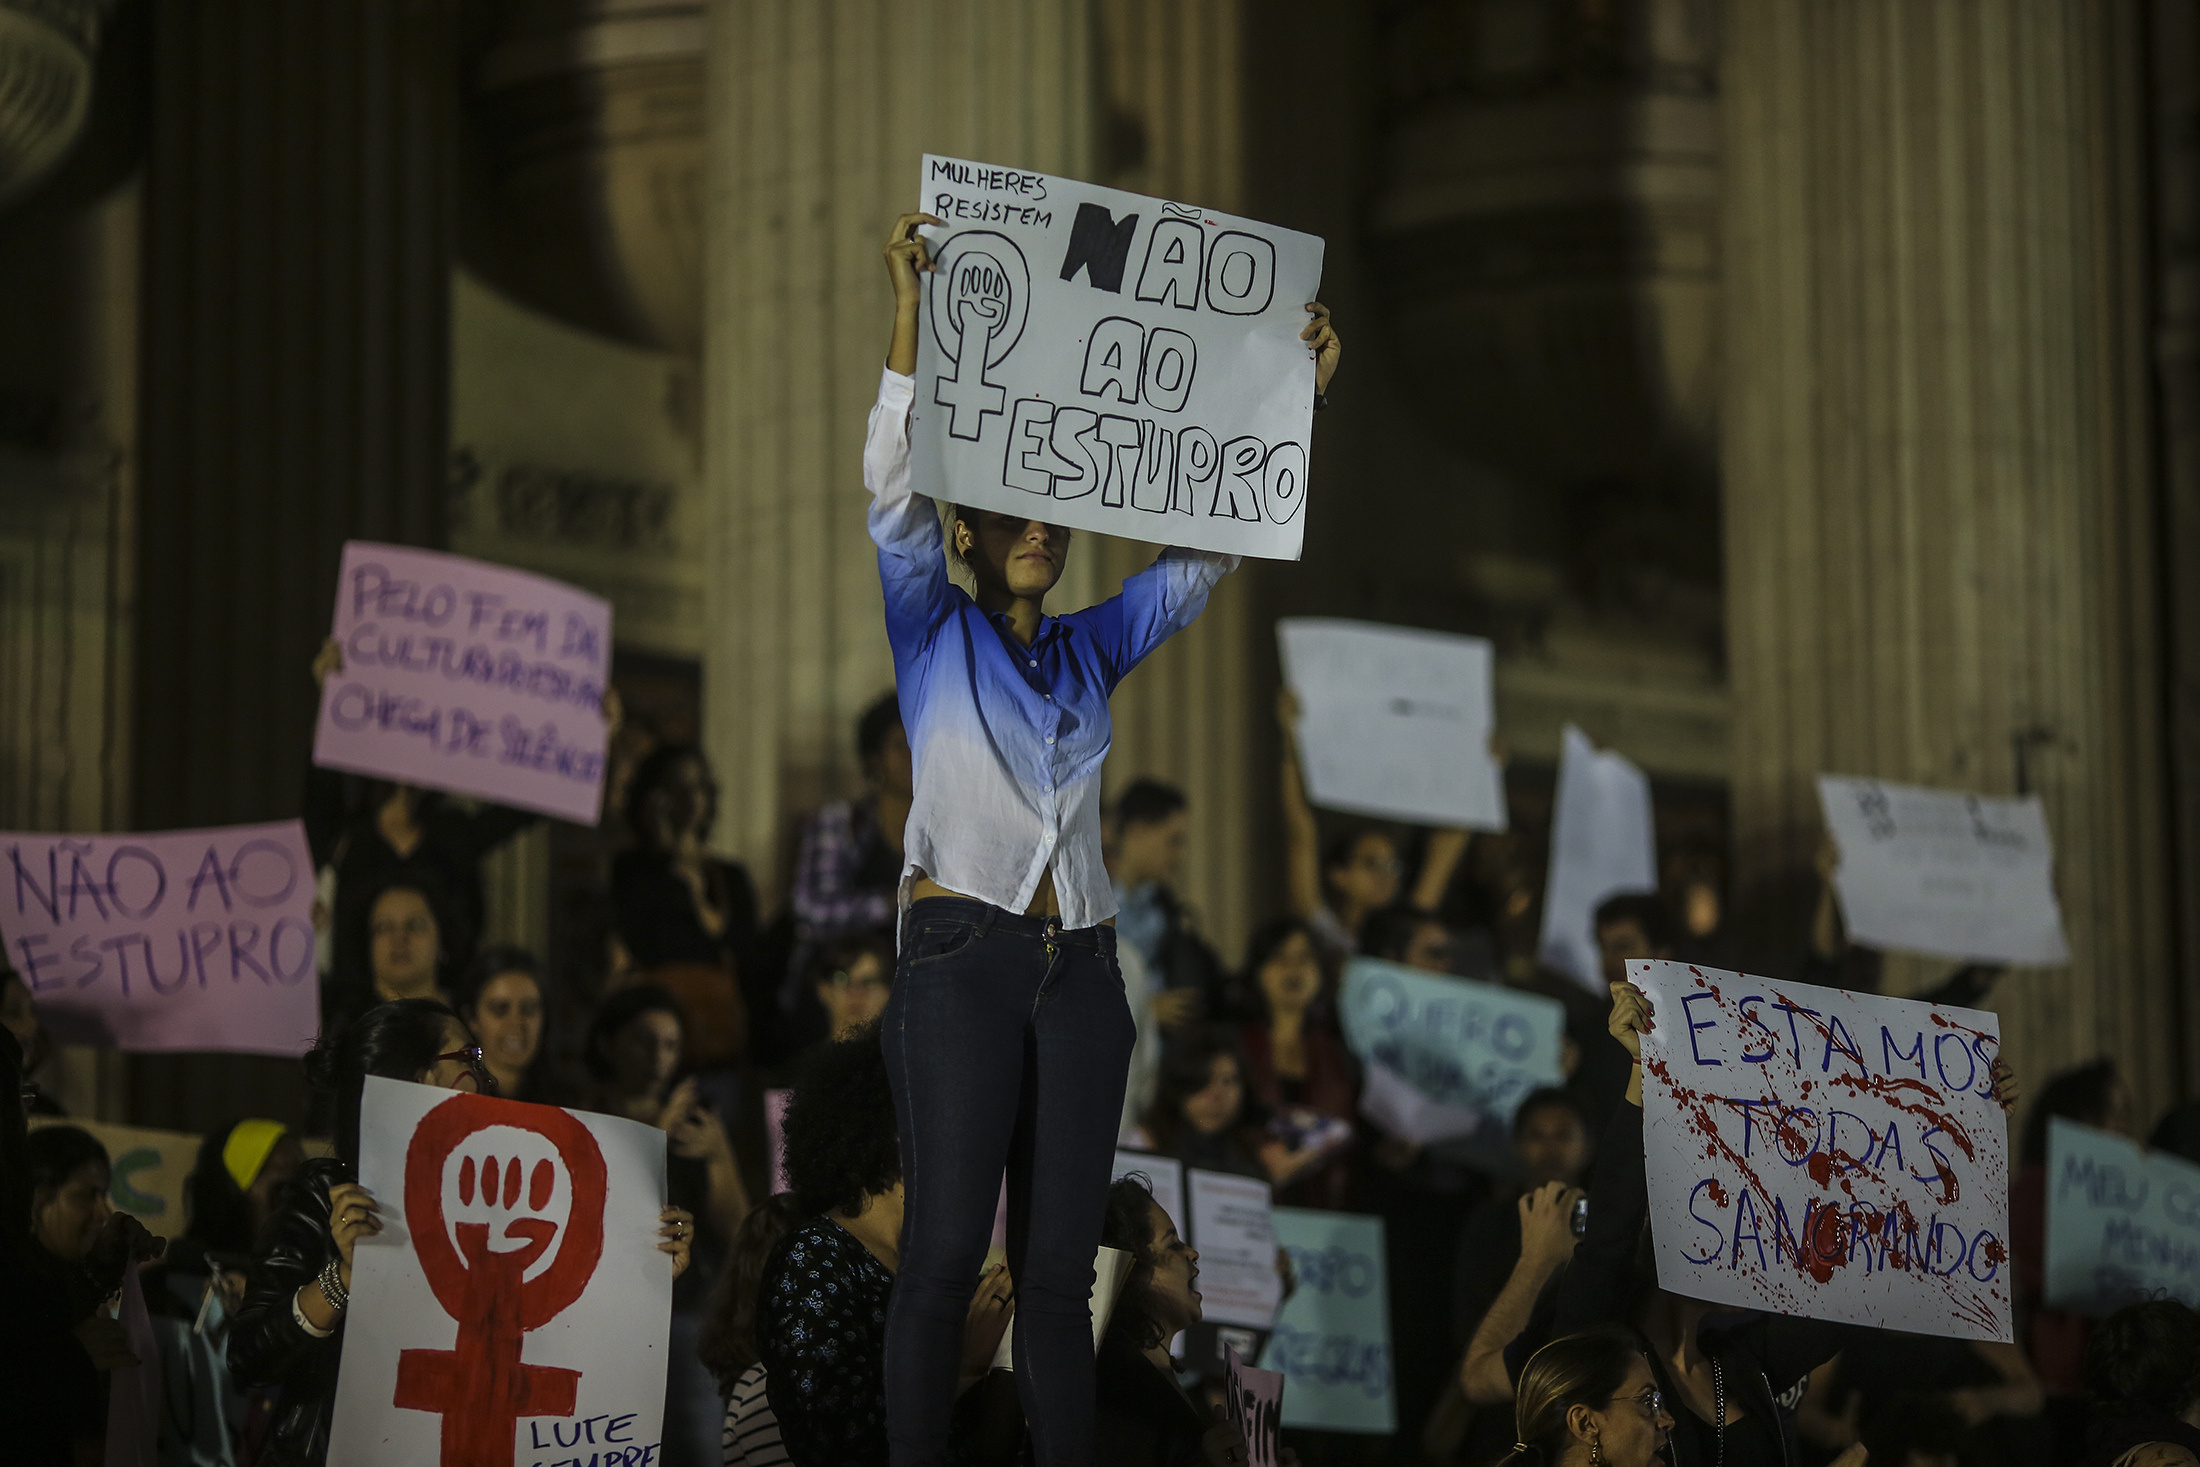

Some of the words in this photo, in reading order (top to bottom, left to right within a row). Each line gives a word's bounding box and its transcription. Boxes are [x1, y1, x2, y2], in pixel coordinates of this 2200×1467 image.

[931, 159, 1048, 200] MULHERES
[1059, 201, 1276, 316] NÃO
[1079, 316, 1197, 412] AO
[1003, 398, 1306, 525] ESTUPRO
[352, 562, 458, 629] PELO
[9, 838, 168, 924] NÃO
[185, 838, 299, 914] AO
[17, 916, 315, 998] ESTUPRO
[1681, 991, 1999, 1100] ESTAMOS
[1723, 1097, 1952, 1183] TODAS
[530, 1413, 639, 1450] LUTE
